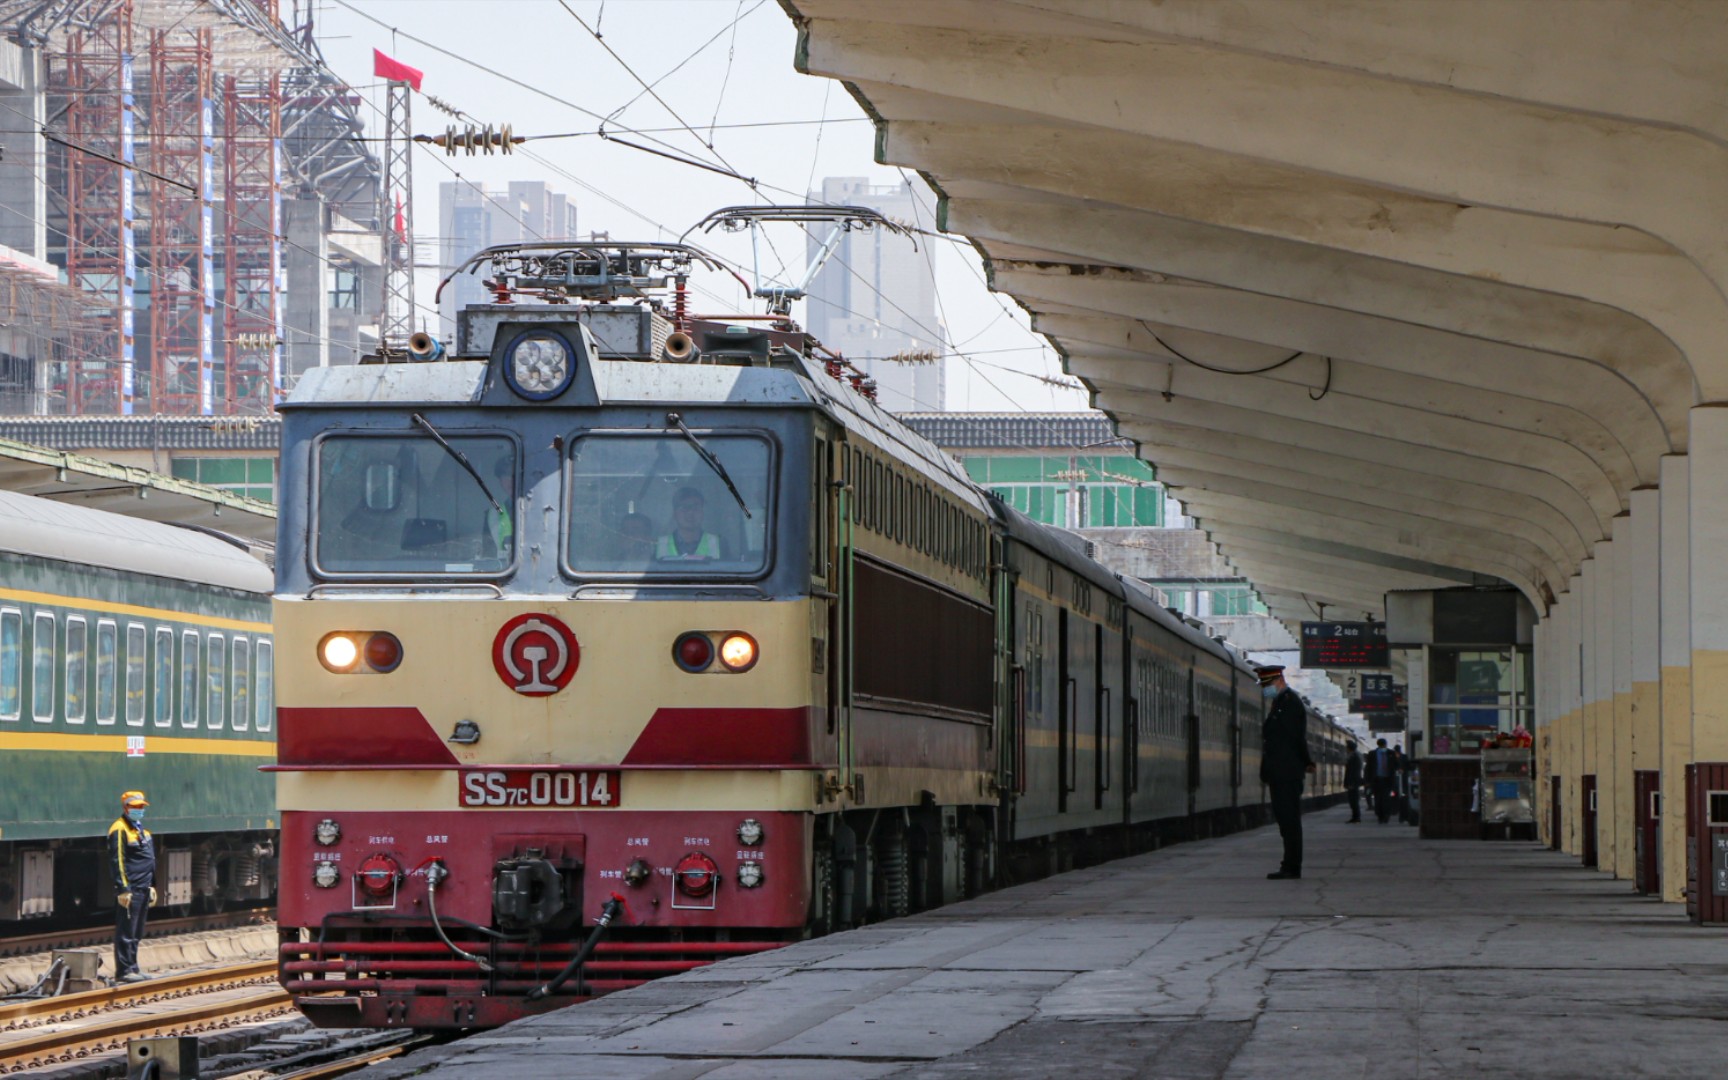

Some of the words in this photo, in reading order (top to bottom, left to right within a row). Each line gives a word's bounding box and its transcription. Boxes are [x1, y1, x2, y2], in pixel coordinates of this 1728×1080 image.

[1348, 677, 1357, 688] 2
[1366, 678, 1389, 690] 西安
[426, 835, 448, 843] 总风管
[627, 837, 649, 846] 总风管
[600, 870, 622, 878] 列车管
